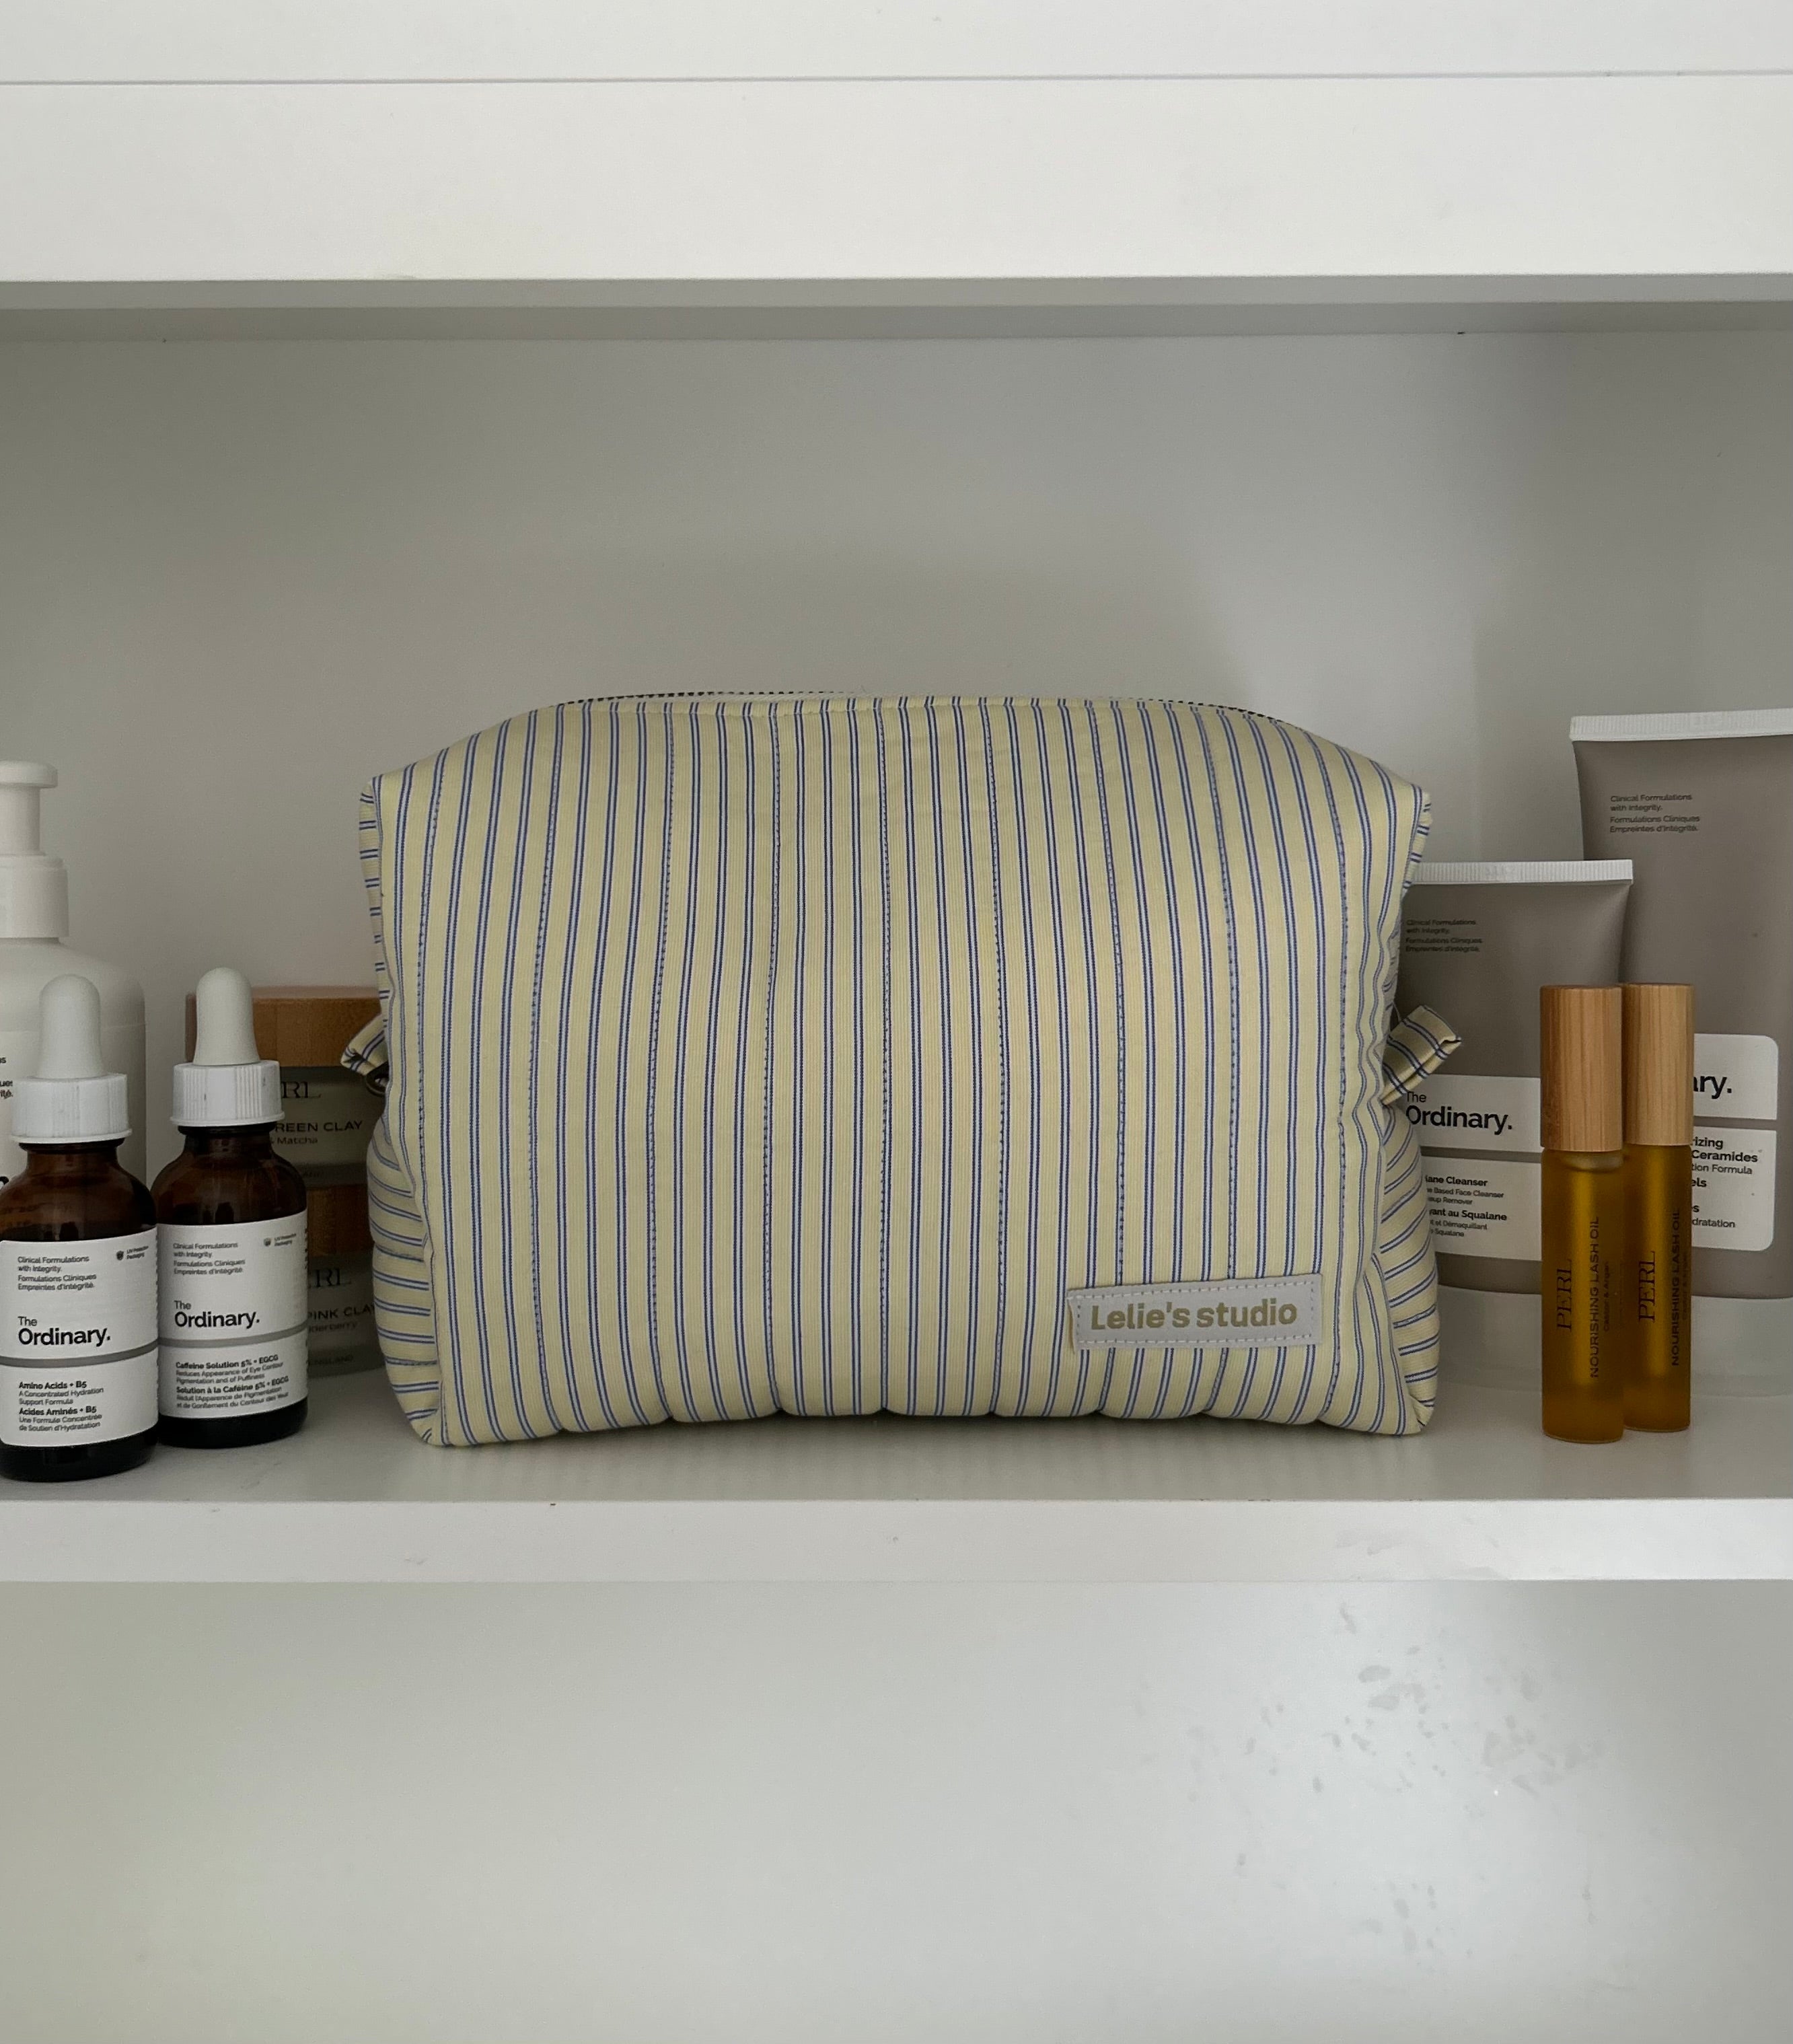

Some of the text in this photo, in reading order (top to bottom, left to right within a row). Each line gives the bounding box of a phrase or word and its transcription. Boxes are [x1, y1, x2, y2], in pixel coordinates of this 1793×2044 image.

[1662, 815, 1700, 824] Cliniques
[1405, 1091, 1427, 1103] The
[324, 1120, 363, 1132] CLAY
[1405, 1105, 1512, 1136] Ordinary.
[277, 1136, 318, 1144] Matcha
[1691, 1149, 1758, 1163] Ceramides
[1712, 1164, 1753, 1175] Formula
[1446, 1176, 1488, 1186] Cleanser
[1473, 1190, 1504, 1198] Cleanser
[1461, 1210, 1507, 1221] Squalane
[1443, 1220, 1488, 1231] Démaquillant
[1435, 1229, 1465, 1237] Squalane
[63, 1274, 97, 1282] Cliniques
[18, 1284, 55, 1292] Empreintes
[1638, 1250, 1656, 1324] PERL
[1671, 1209, 1680, 1366] NOURISHING LASH OIL
[1556, 1259, 1572, 1333] PERL
[1589, 1216, 1599, 1379] NOURISHING LASH OIL
[174, 1300, 192, 1310] The
[1091, 1297, 1298, 1330] Lelie's studio
[17, 1316, 38, 1327] The
[174, 1311, 260, 1329] Ordinary.
[18, 1327, 110, 1347] Ordinary.
[206, 1360, 240, 1369] Solution
[241, 1358, 252, 1368] 5%
[259, 1354, 279, 1364] EGCG
[201, 1368, 240, 1378] Appearance
[250, 1366, 261, 1375] Eye
[262, 1362, 284, 1371] Contour
[237, 1374, 265, 1382] Puffiness
[19, 1381, 43, 1389] Amino
[44, 1381, 67, 1389] Acids
[76, 1381, 87, 1389] B5
[207, 1386, 212, 1394] à
[223, 1384, 254, 1393] Caféine
[255, 1381, 266, 1391] 5%
[71, 1387, 104, 1397] Hydration
[244, 1386, 283, 1399] Pigmentation
[19, 1398, 44, 1406] Support
[240, 1397, 264, 1406] Contour
[19, 1408, 44, 1416] Acides
[46, 1406, 78, 1416] Aminés
[85, 1406, 97, 1414] B5
[62, 1414, 102, 1423] Concentrée
[54, 1421, 101, 1432] d'Hydratation
